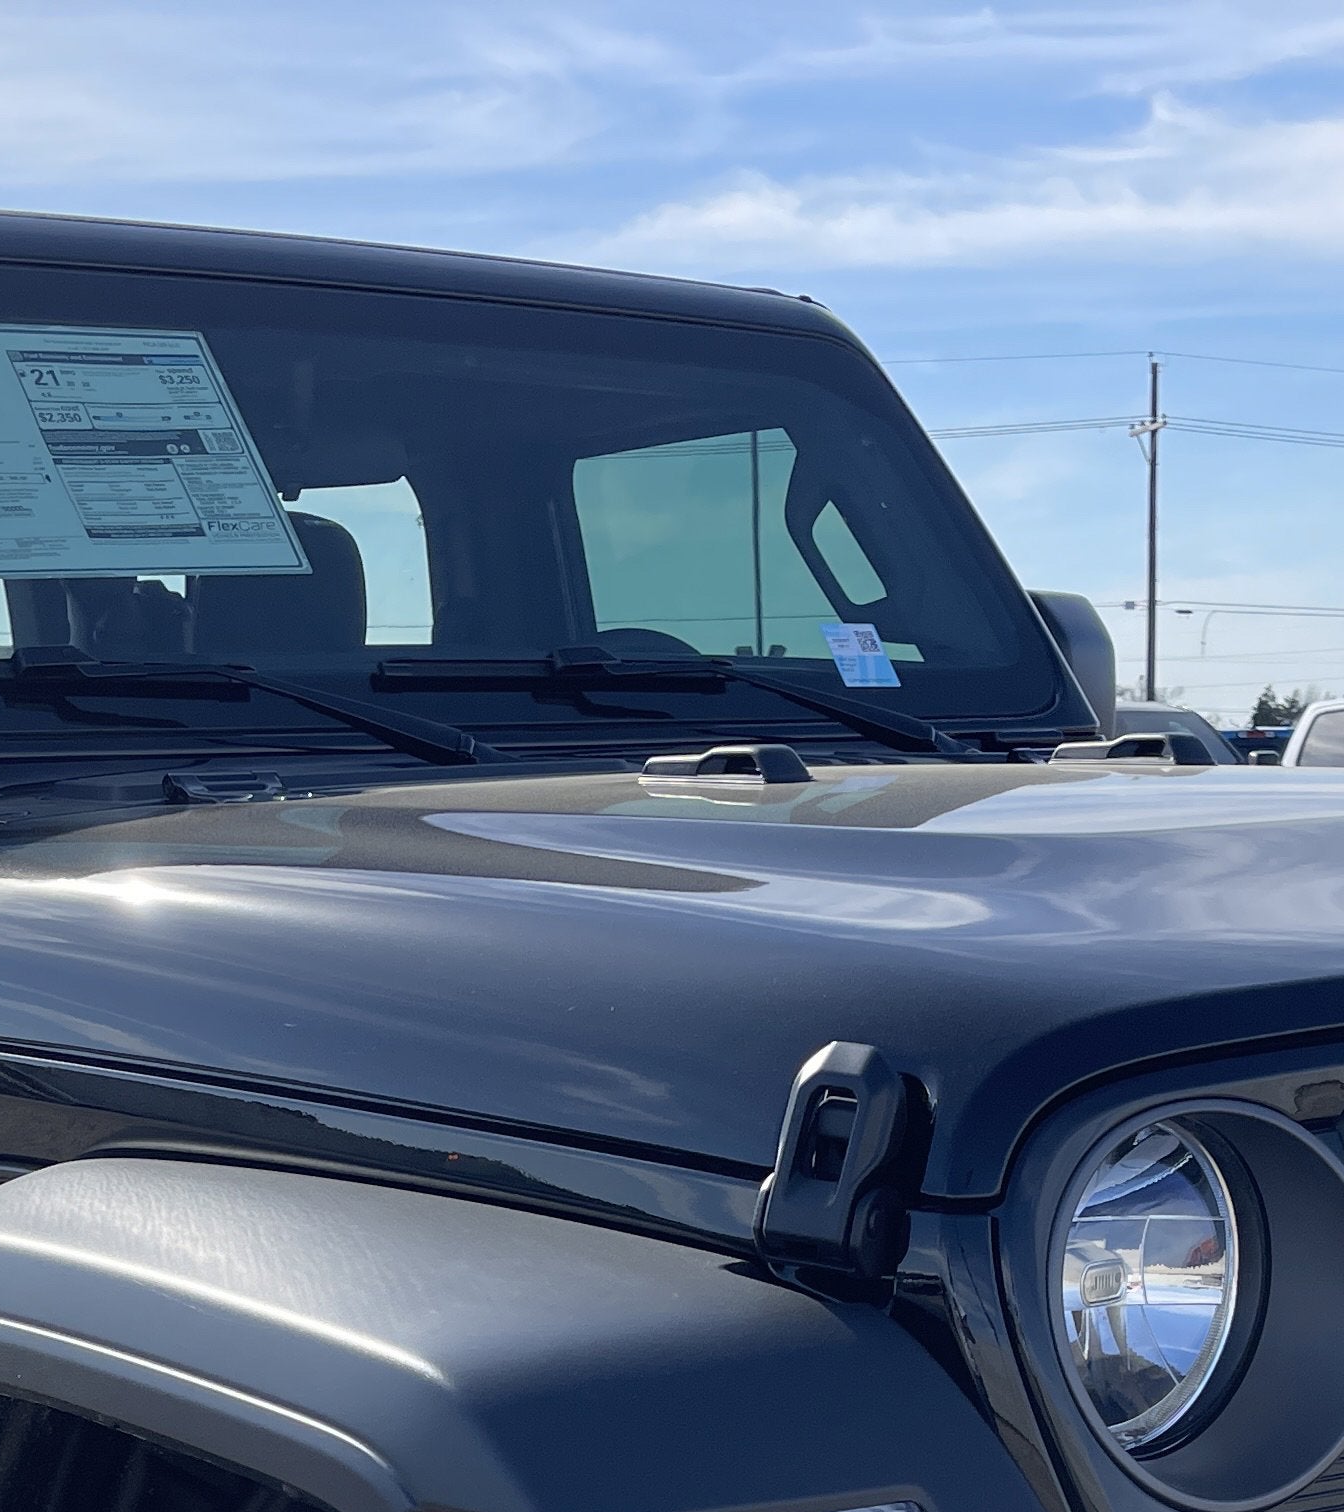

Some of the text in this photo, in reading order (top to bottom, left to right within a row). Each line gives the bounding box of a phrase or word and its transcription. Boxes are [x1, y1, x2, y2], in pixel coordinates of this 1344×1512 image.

[30, 368, 61, 387] 21
[158, 374, 201, 385] $3,250
[38, 412, 83, 424] $2,350
[207, 519, 276, 532] FlexCare
